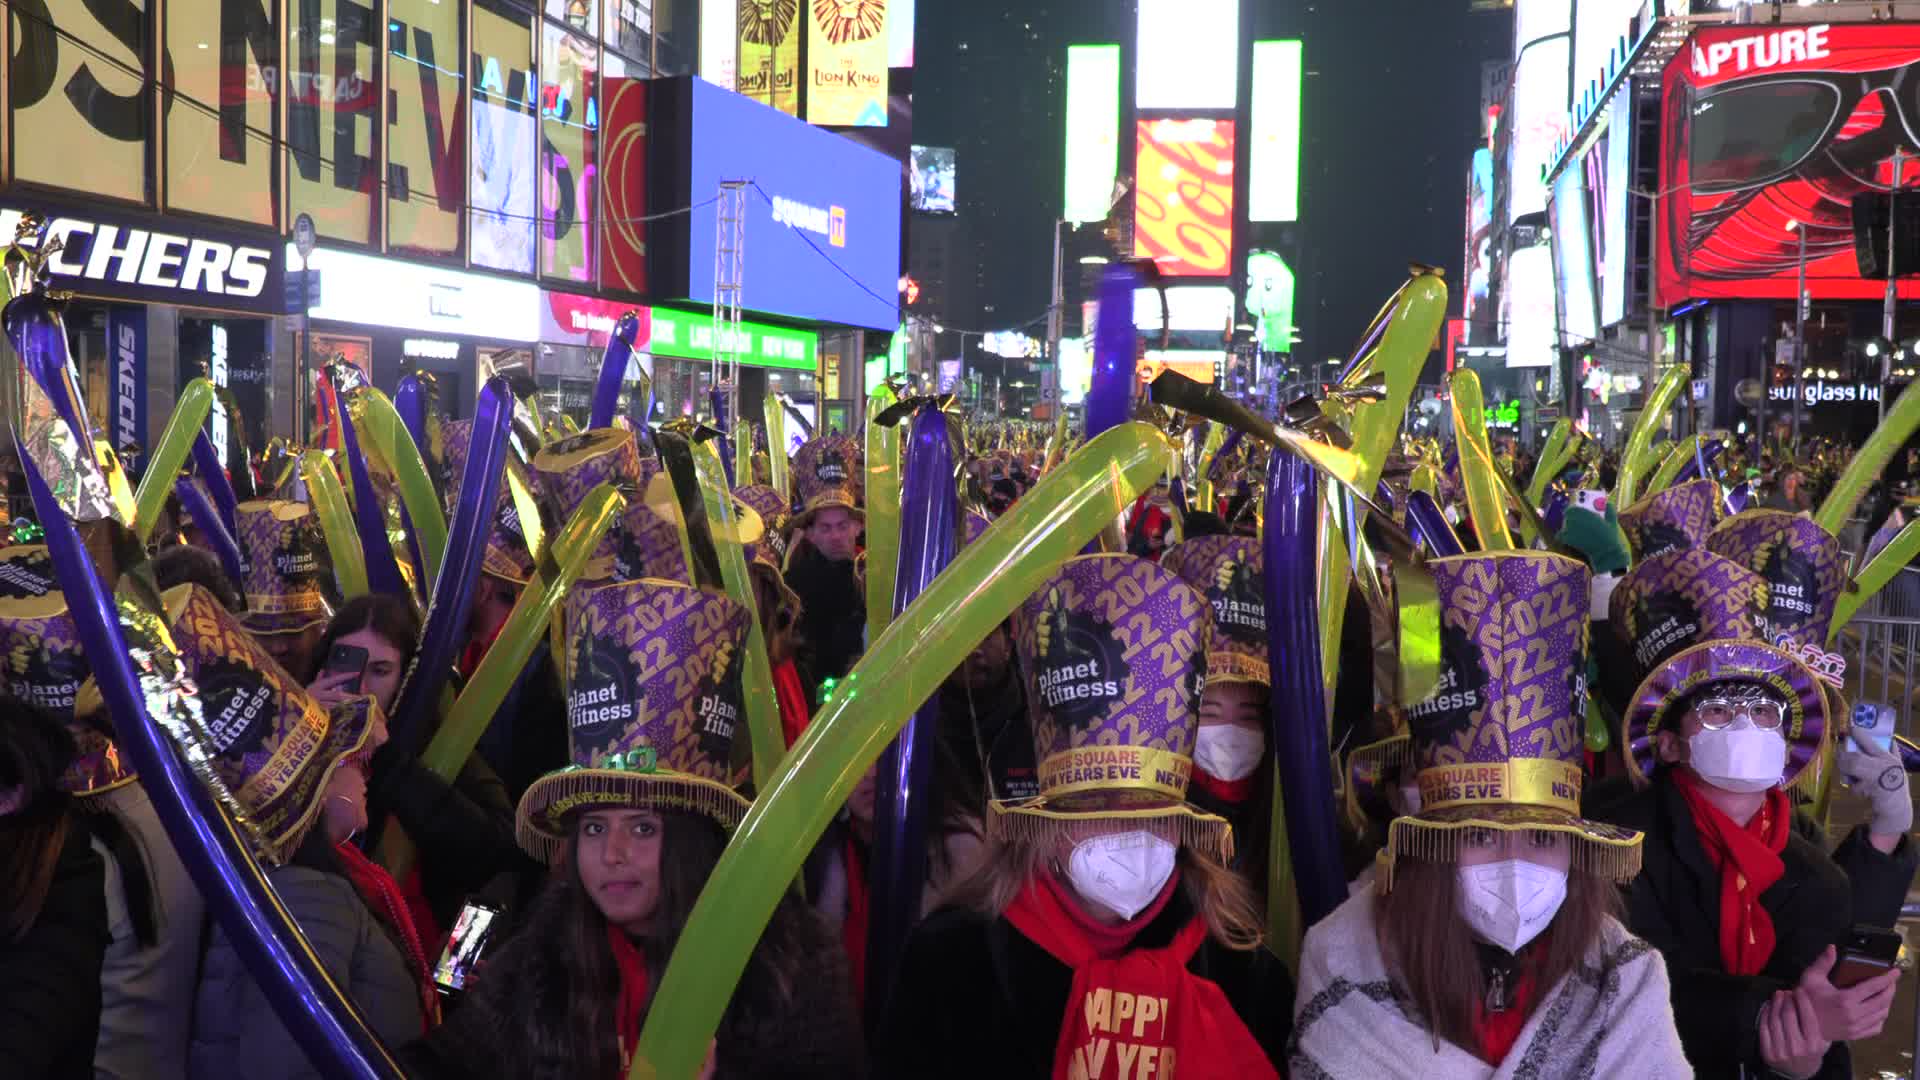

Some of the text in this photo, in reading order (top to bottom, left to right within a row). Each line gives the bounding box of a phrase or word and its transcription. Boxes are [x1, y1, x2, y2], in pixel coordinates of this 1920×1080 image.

[815, 68, 880, 87] LION KING
[277, 552, 313, 568] planet
[1038, 659, 1101, 695] planet
[569, 683, 617, 717] planet
[1046, 680, 1119, 708] fitness
[212, 686, 272, 753] fitness
[571, 703, 632, 729] fitness
[277, 740, 314, 786] YEARS
[1073, 751, 1141, 767] SQUARE
[1059, 768, 1105, 785] YEARS
[1107, 765, 1140, 780] EVE
[1155, 769, 1187, 791] NEW
[1465, 784, 1502, 800] EVE
